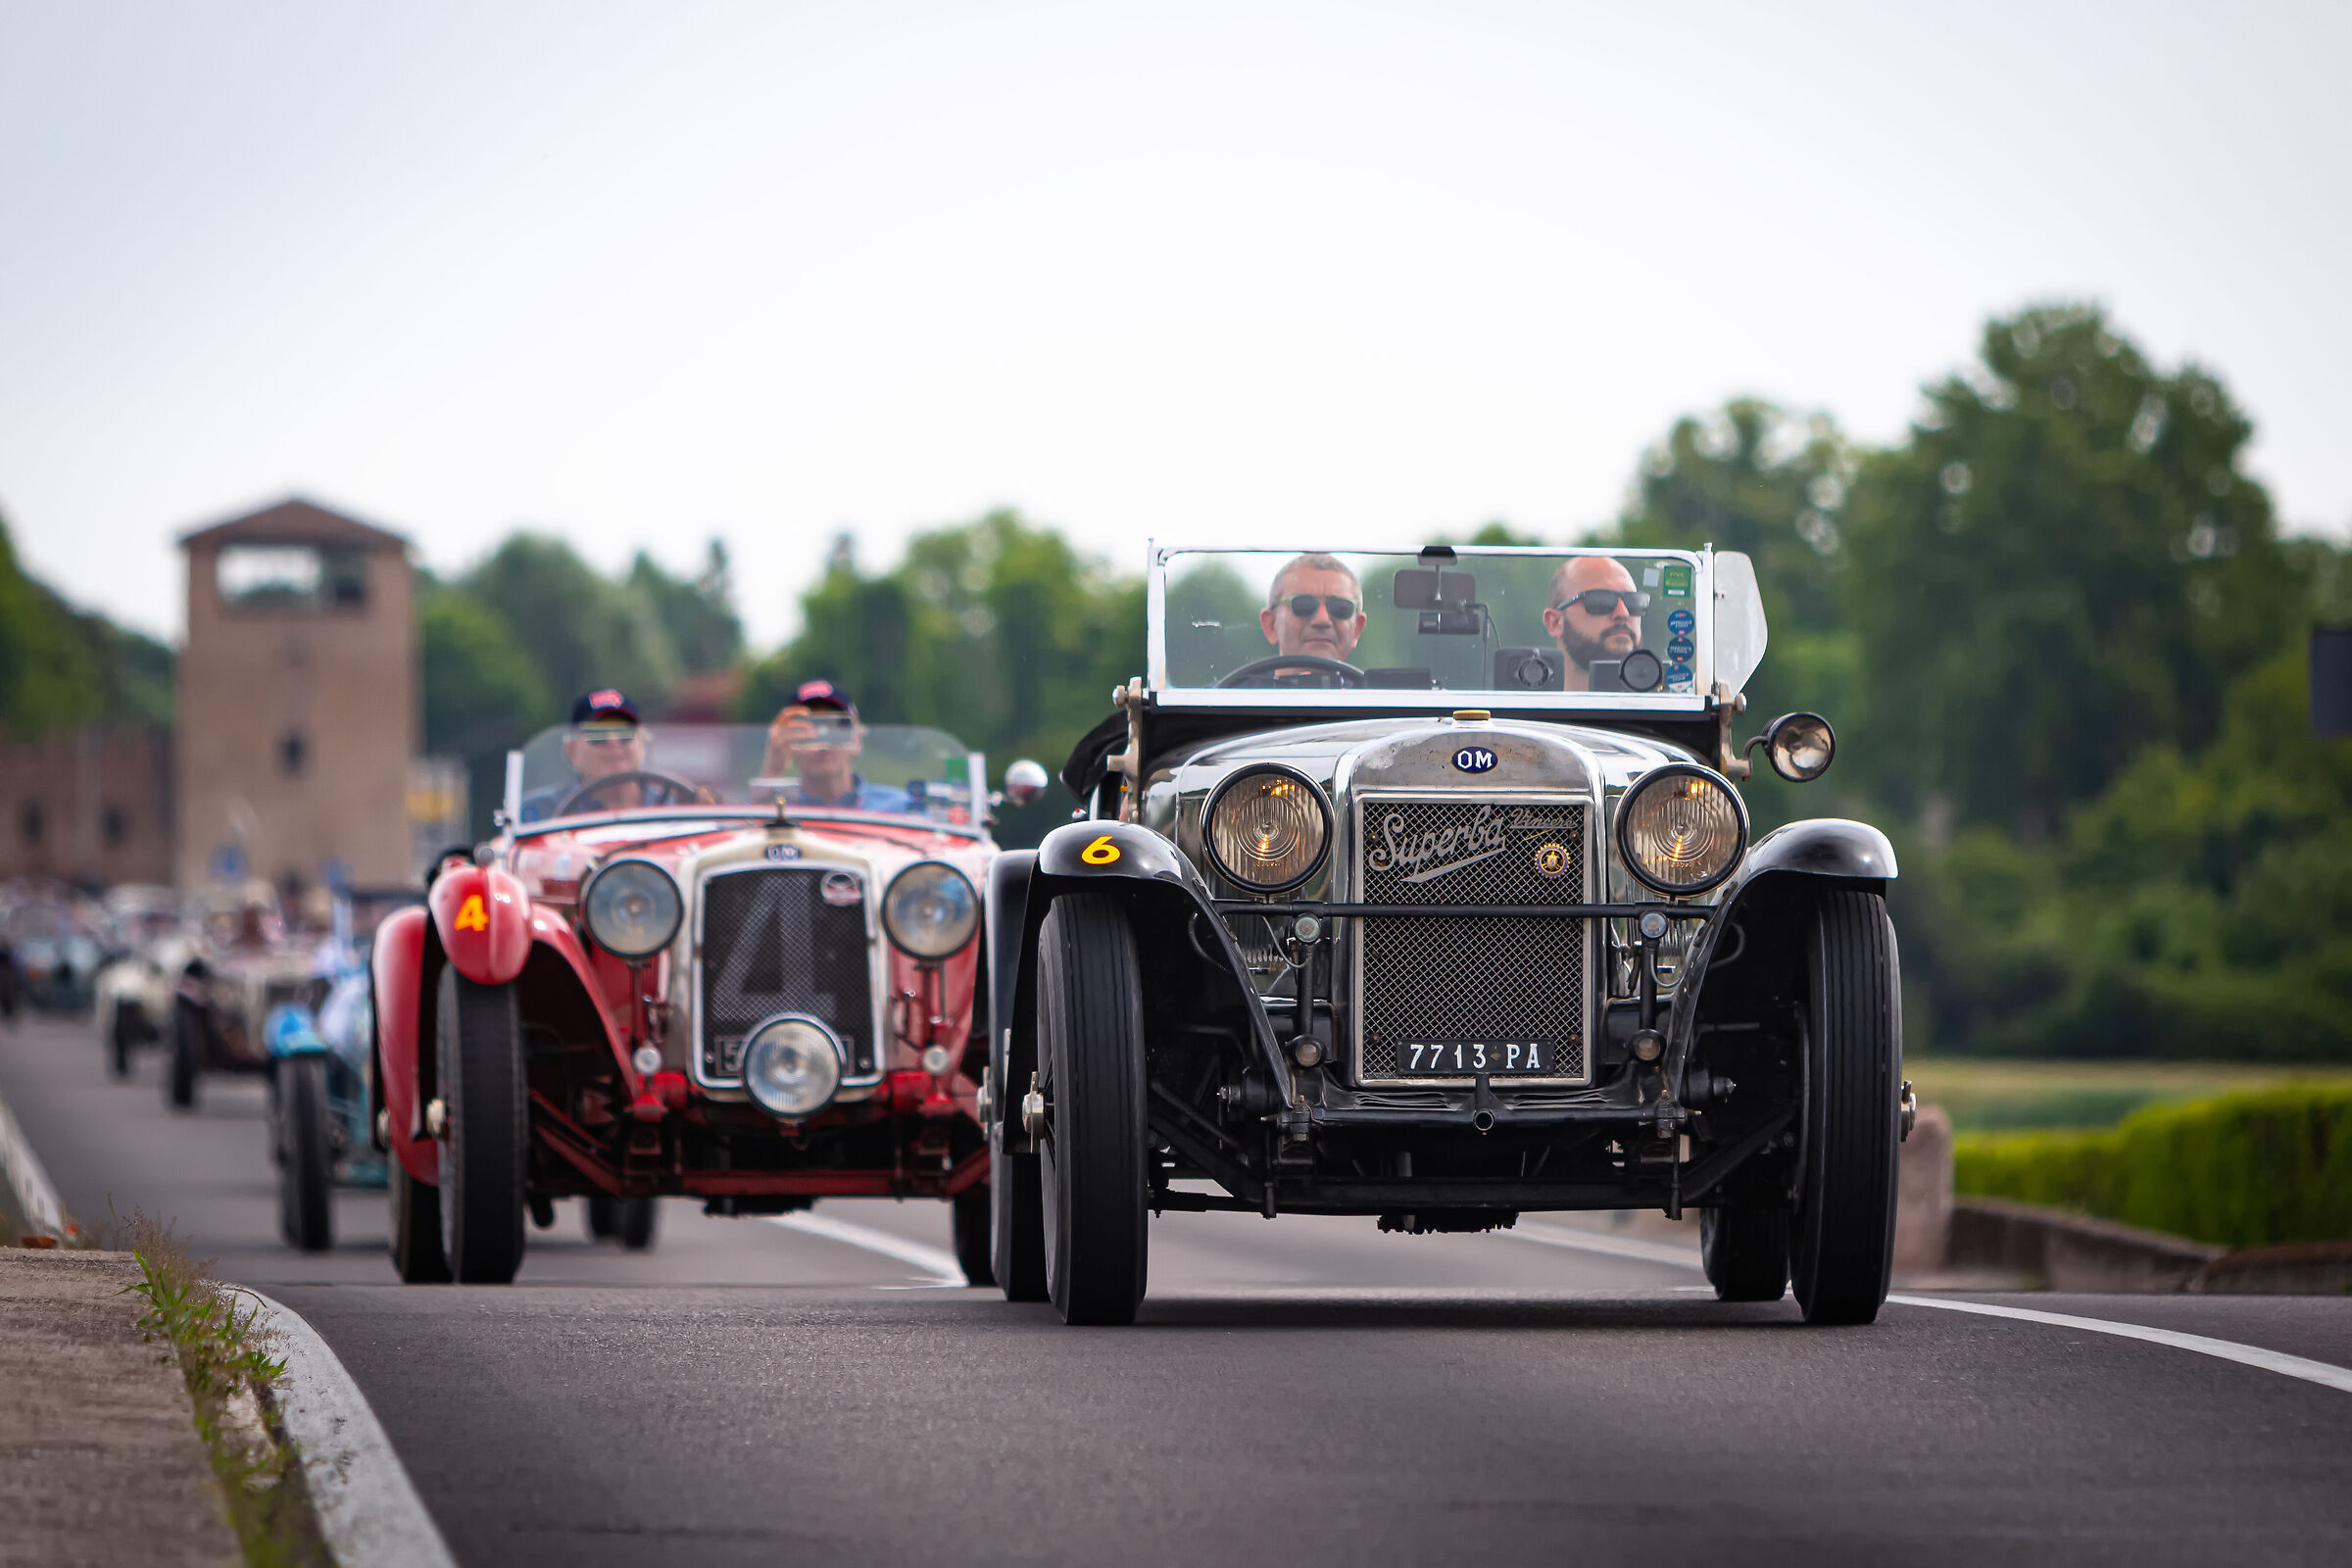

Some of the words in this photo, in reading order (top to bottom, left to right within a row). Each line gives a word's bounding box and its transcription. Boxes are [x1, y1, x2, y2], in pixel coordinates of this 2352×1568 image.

[1457, 750, 1493, 769] OM
[1081, 835, 1121, 865] 6
[1369, 805, 1506, 882] Superba
[454, 894, 489, 932] 4
[712, 875, 836, 1021] 4
[1410, 1044, 1487, 1070] 7713
[1505, 1043, 1541, 1070] PA
